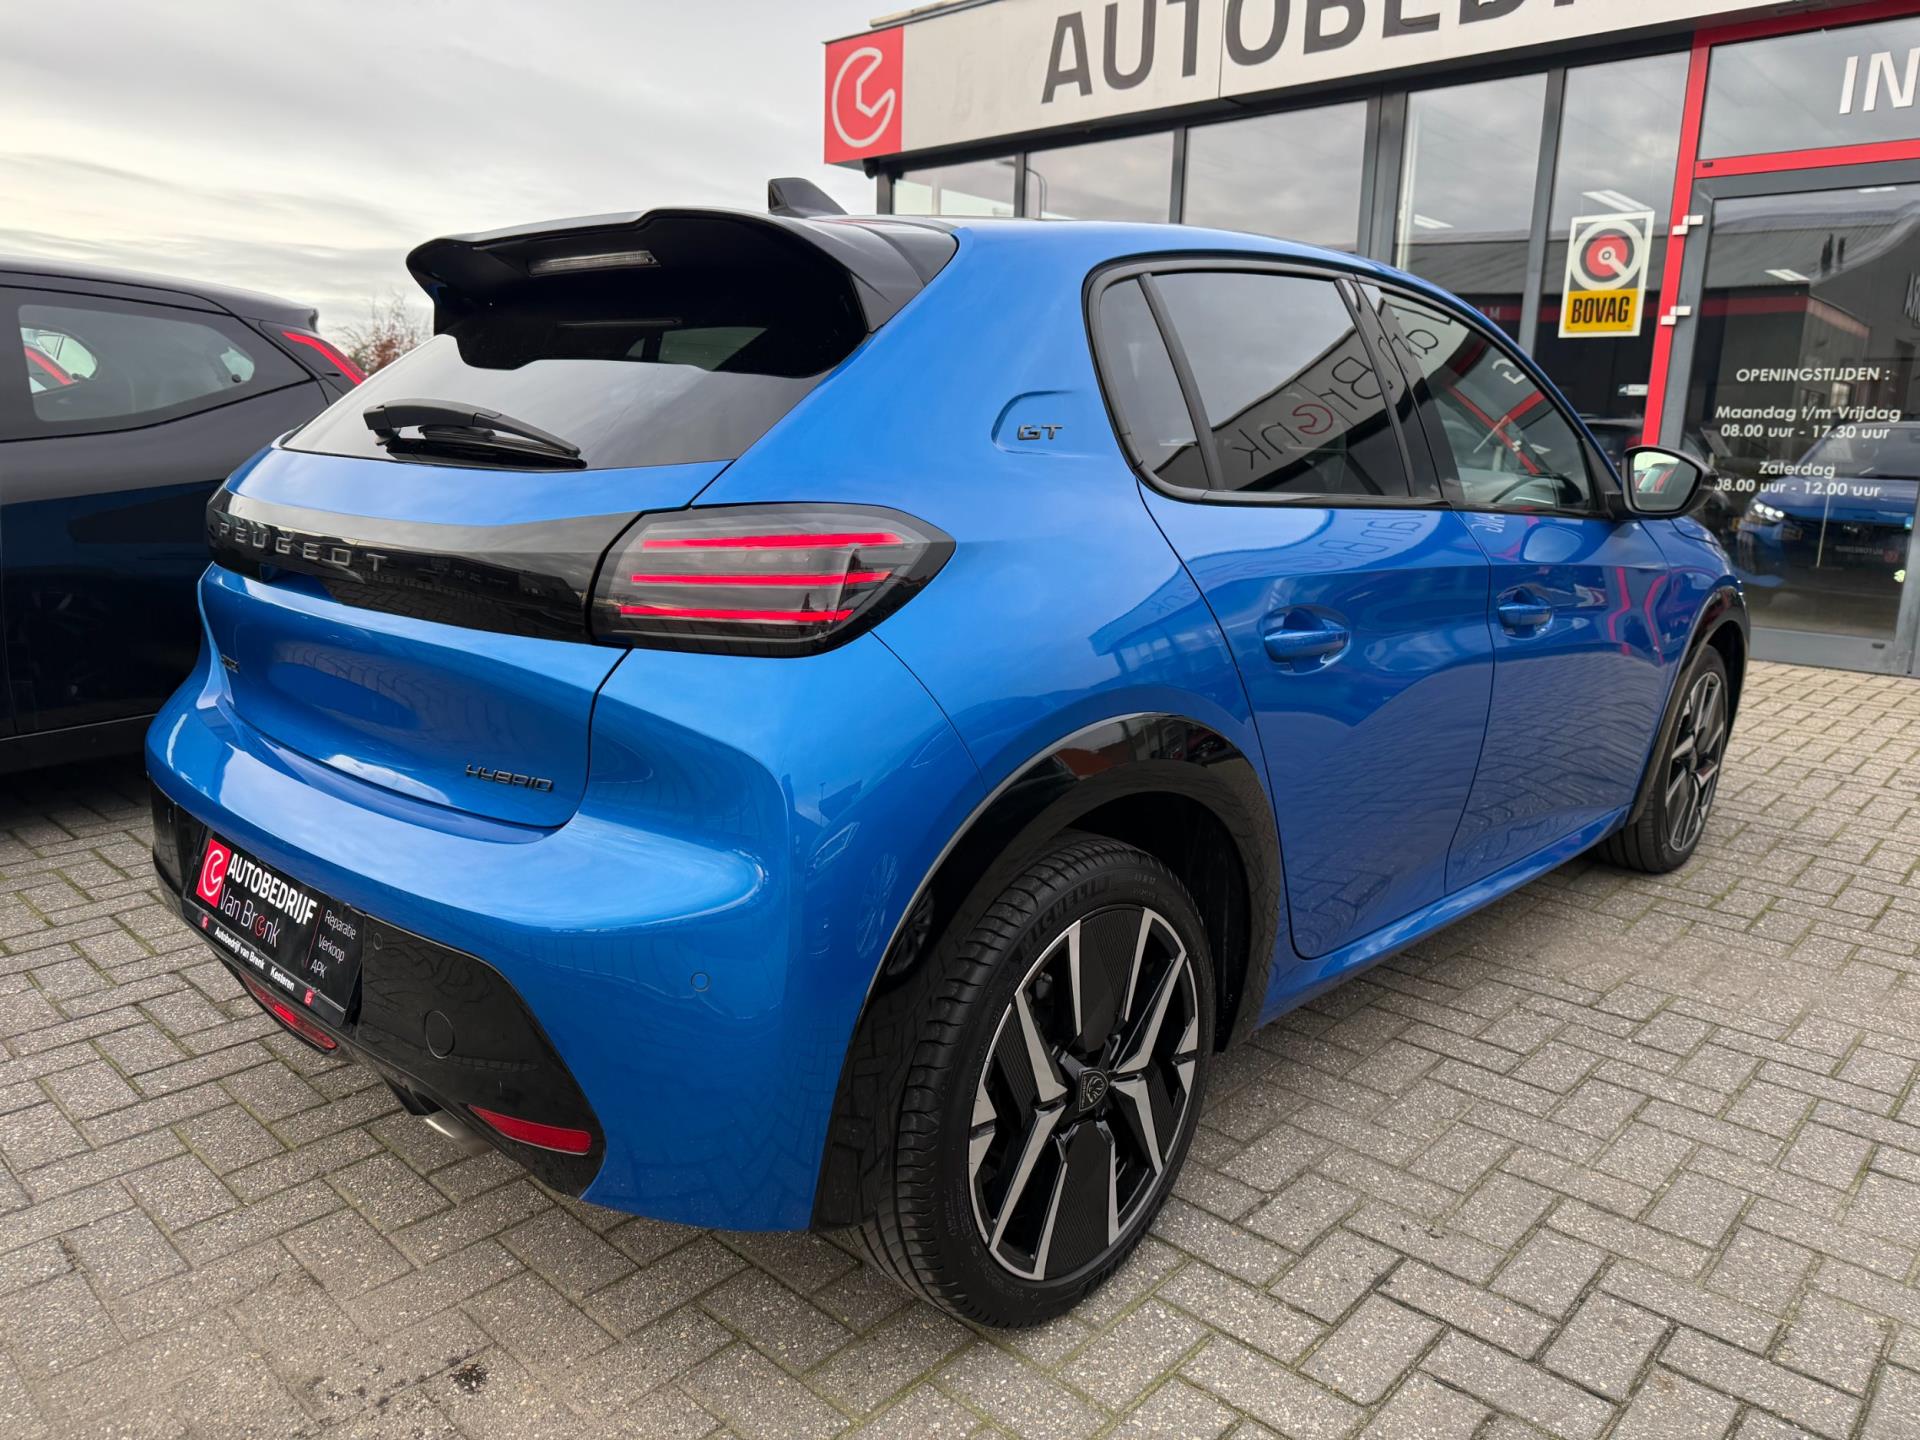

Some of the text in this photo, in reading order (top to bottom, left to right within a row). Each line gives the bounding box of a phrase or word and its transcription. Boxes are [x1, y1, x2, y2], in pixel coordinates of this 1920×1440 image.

[1041, 0, 1576, 104] AUTOB
[1570, 296, 1631, 325] BOVAG
[1735, 367, 1881, 382] OPENINGSTIJDEN
[1715, 406, 1902, 422] Maandag t/m Vrijdag
[1017, 425, 1063, 441] GT
[1720, 424, 1763, 438] 08.00
[1768, 426, 1795, 438] uur
[1812, 425, 1856, 439] 17.30
[1861, 427, 1891, 439] uur
[1758, 461, 1836, 478] Zaterdag
[1760, 480, 1786, 493] uur
[1804, 482, 1848, 496] 12.00
[1851, 484, 1881, 497] uur
[218, 522, 388, 572] PEUGEOT
[466, 764, 553, 792] HYBRID
[219, 883, 240, 921] Van
[227, 853, 318, 926] AUTOBEDRIJF
[324, 909, 357, 940] Reparatie
[214, 926, 241, 953] Autobedrijf
[239, 945, 250, 959] van
[270, 965, 295, 992] Kesteren
[318, 933, 346, 964] Verkoop
[310, 958, 328, 979] APK
